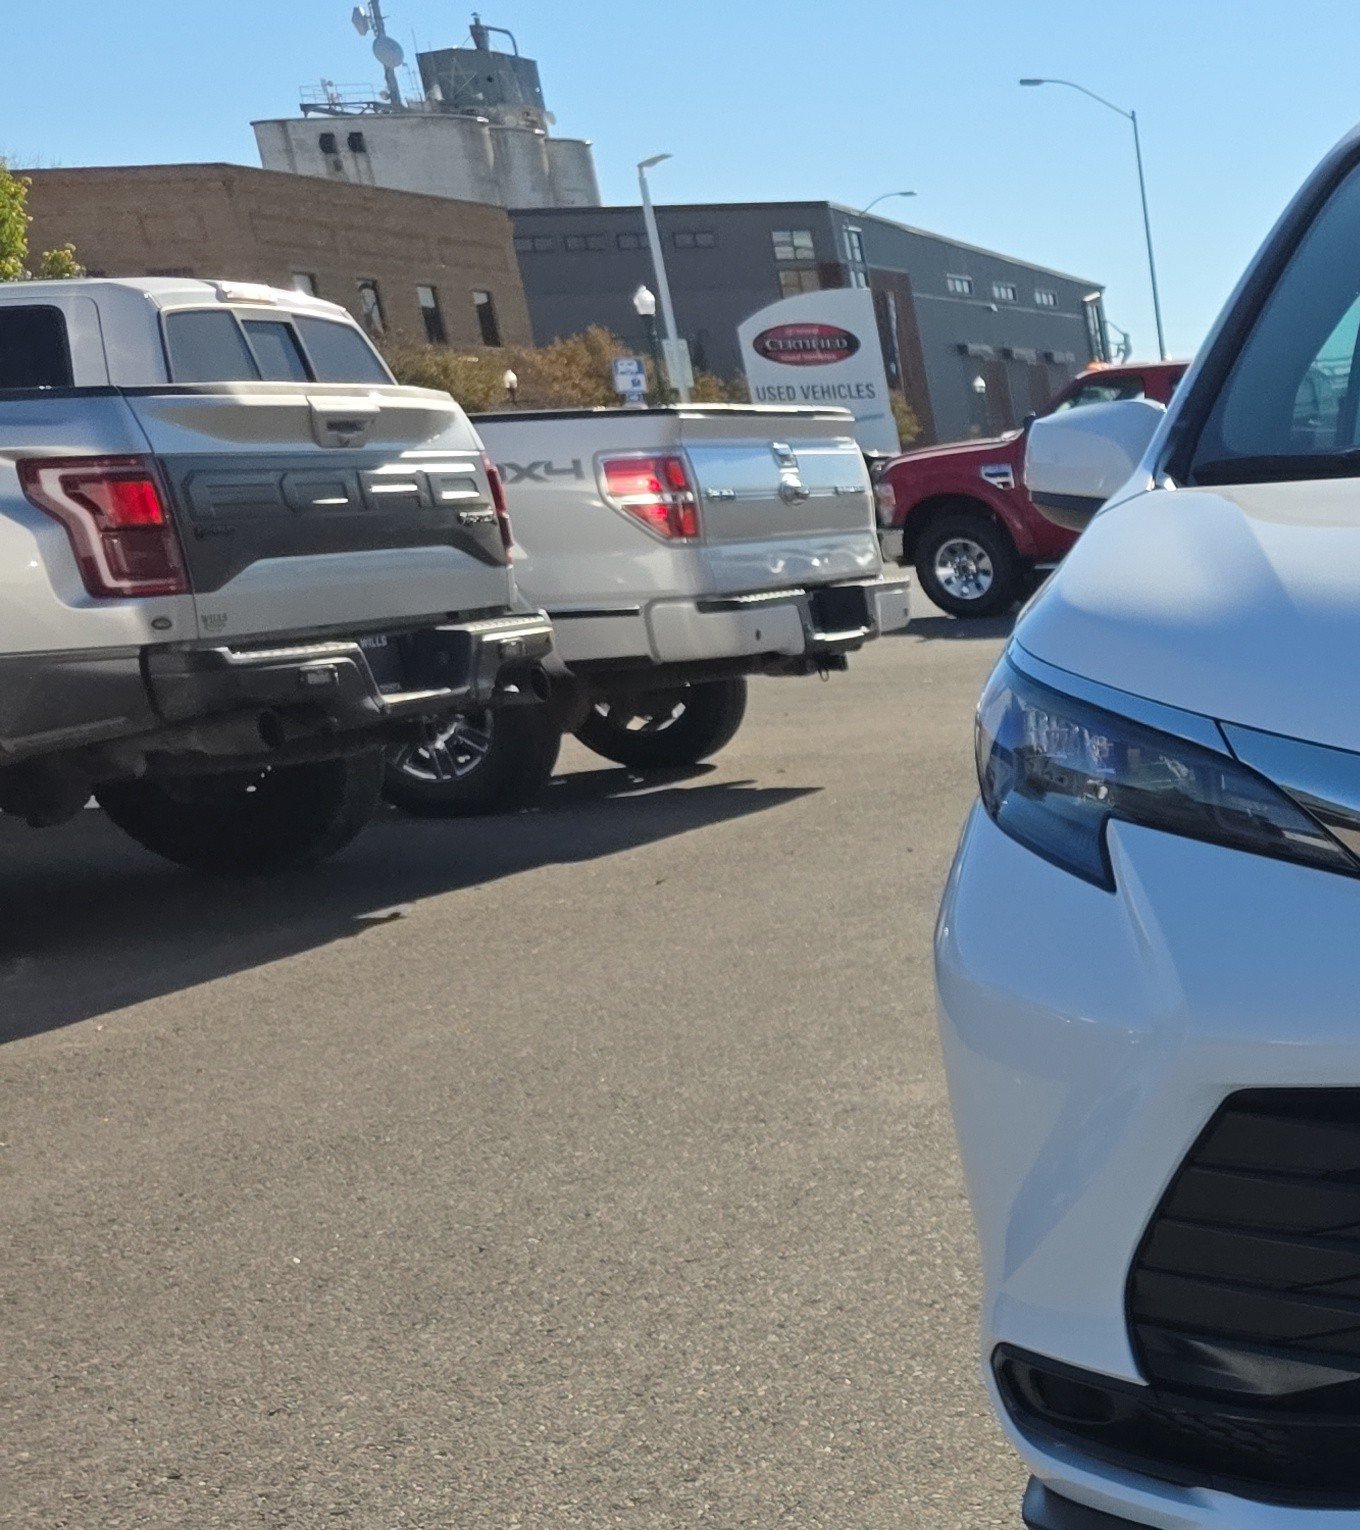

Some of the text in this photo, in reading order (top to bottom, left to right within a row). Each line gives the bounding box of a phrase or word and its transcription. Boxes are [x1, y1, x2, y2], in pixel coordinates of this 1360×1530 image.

[764, 338, 848, 351] CERTIFIED
[756, 383, 876, 401] USED VEHICLES
